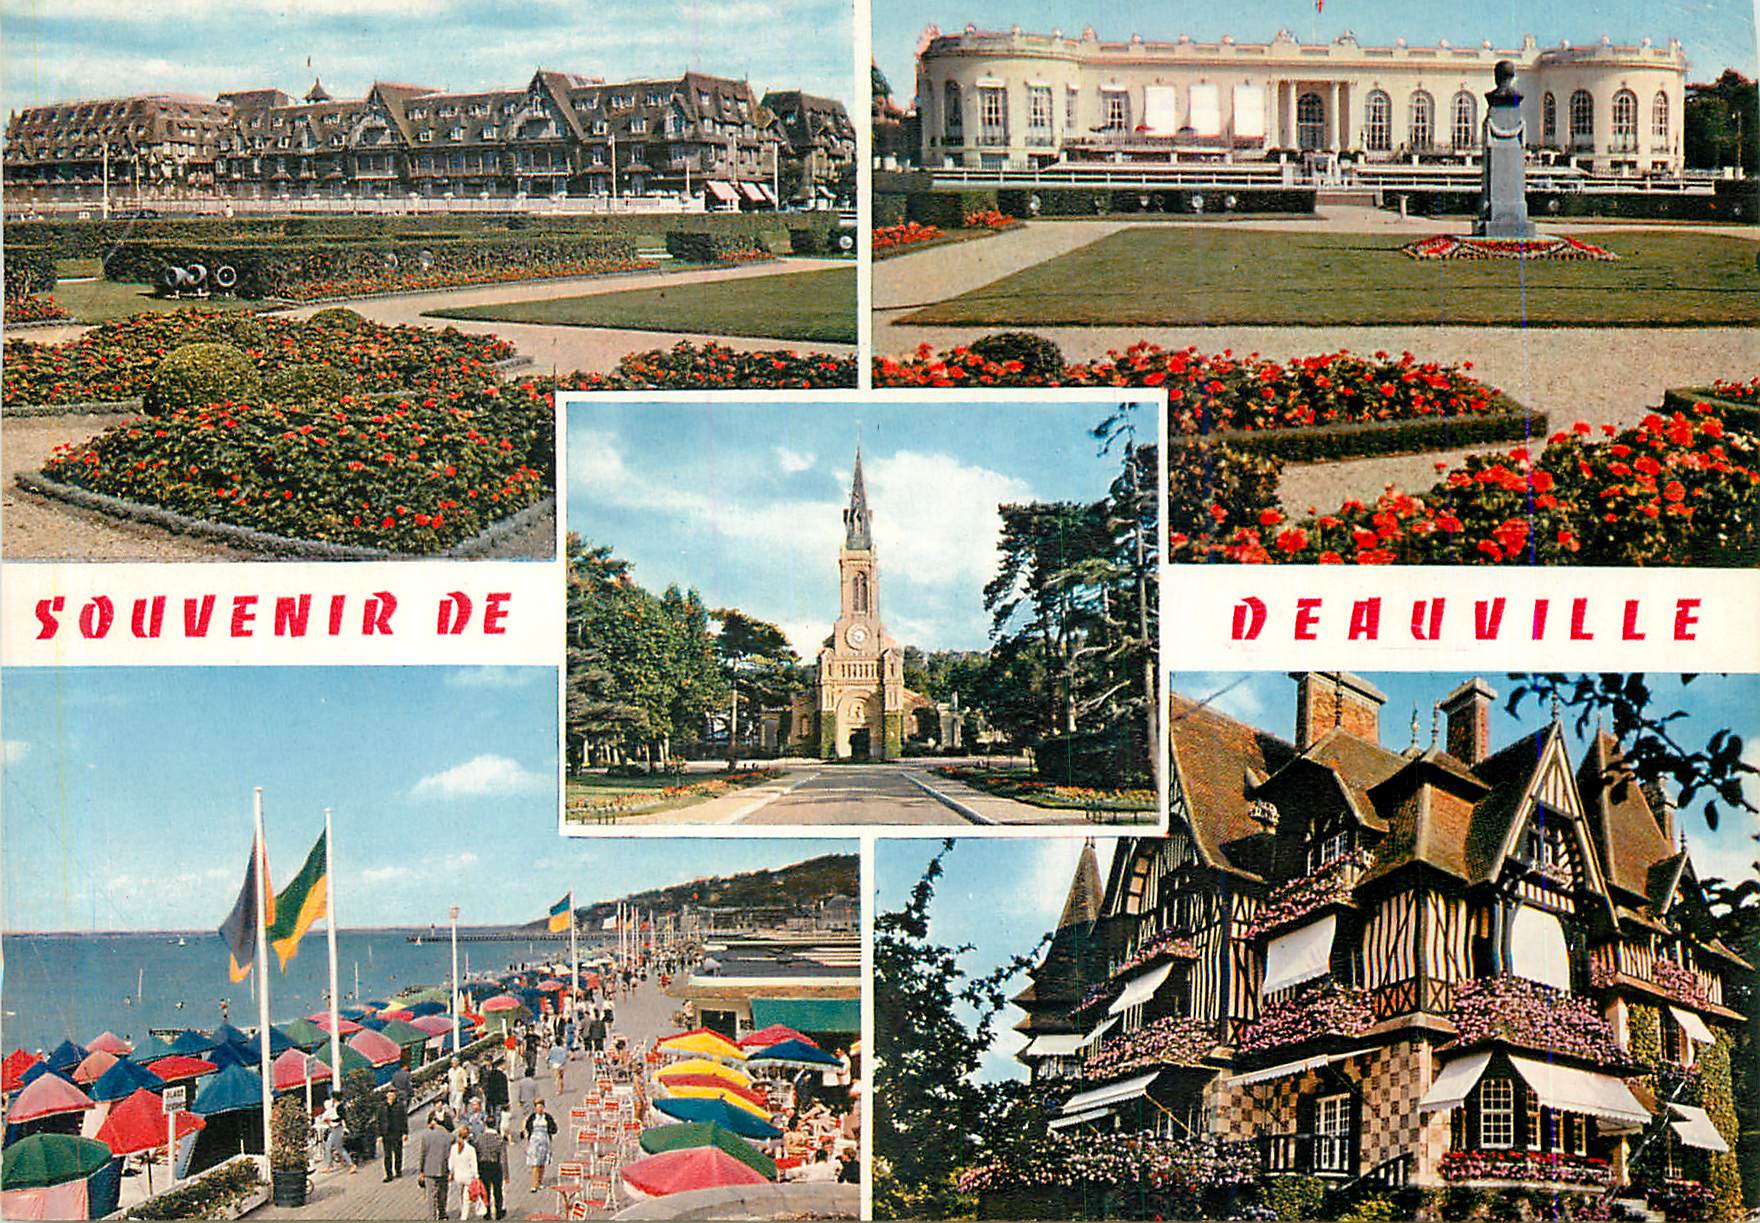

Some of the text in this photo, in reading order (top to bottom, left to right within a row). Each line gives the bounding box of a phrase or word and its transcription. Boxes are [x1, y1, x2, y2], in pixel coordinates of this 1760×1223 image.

[34, 591, 1702, 641] SOUVENIR DE DEAUVILLE
